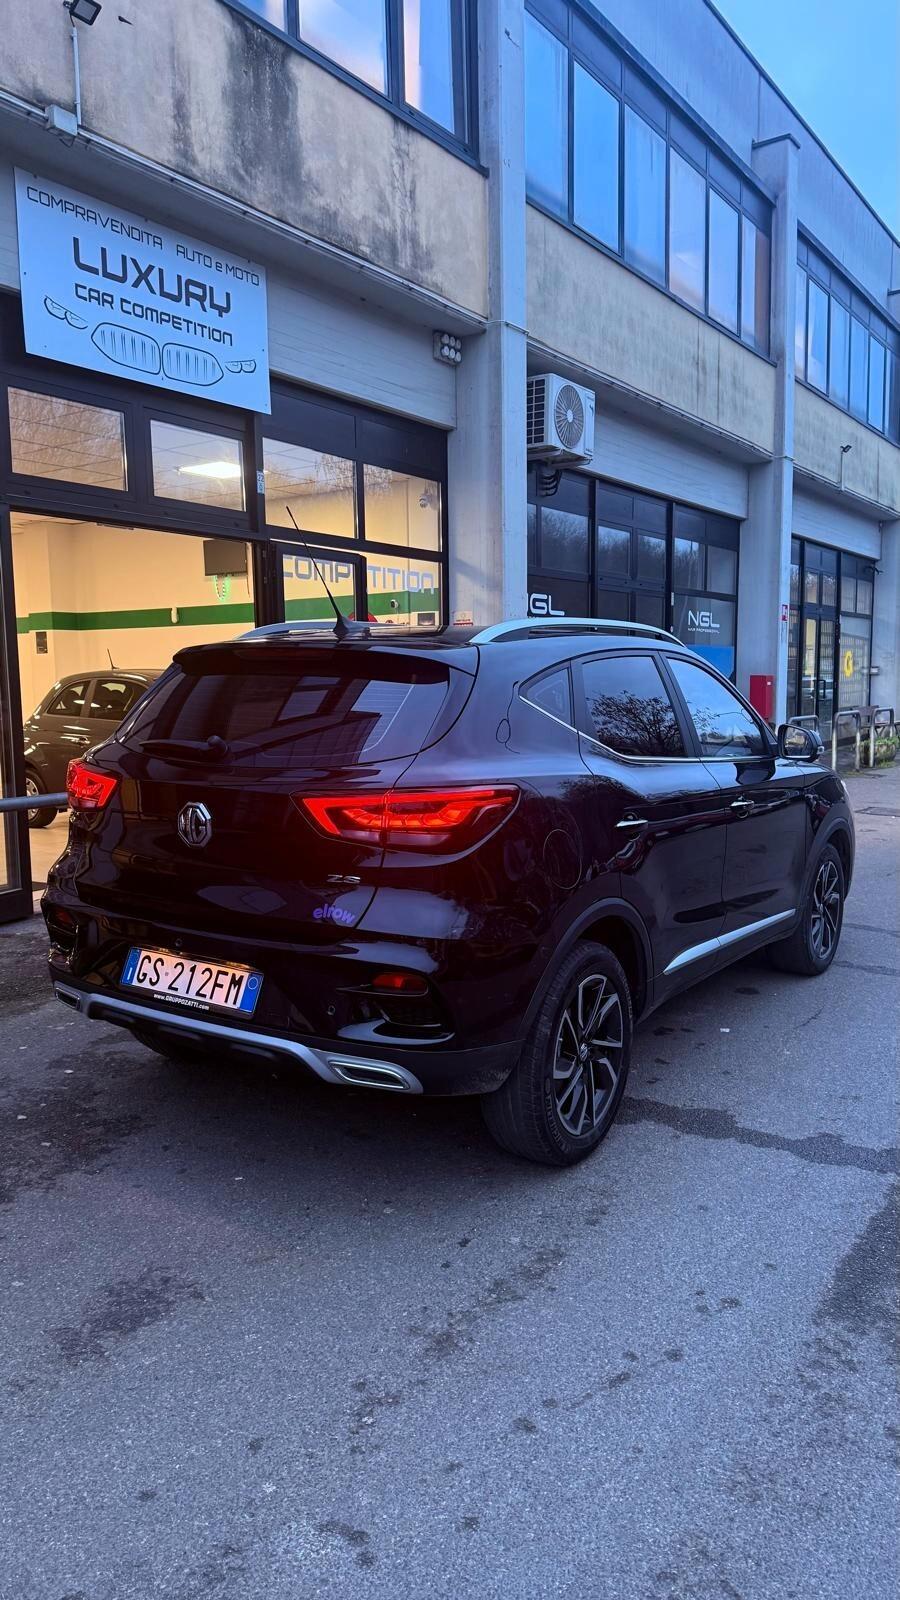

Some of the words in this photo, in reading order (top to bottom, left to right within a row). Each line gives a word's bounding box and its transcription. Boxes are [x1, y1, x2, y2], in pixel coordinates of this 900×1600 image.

[26, 186, 163, 250] COMPRAVENDITA
[176, 243, 213, 269] AUTO
[215, 261, 223, 273] e
[225, 263, 260, 287] MOTO
[72, 236, 231, 318] LUXURY
[74, 282, 115, 310] CAR
[120, 297, 233, 346] COMPETITION
[283, 554, 434, 594] COMPTITION
[527, 593, 565, 616] GL
[687, 610, 720, 628] NGL
[326, 873, 361, 884] ZS
[312, 903, 356, 924] elrow
